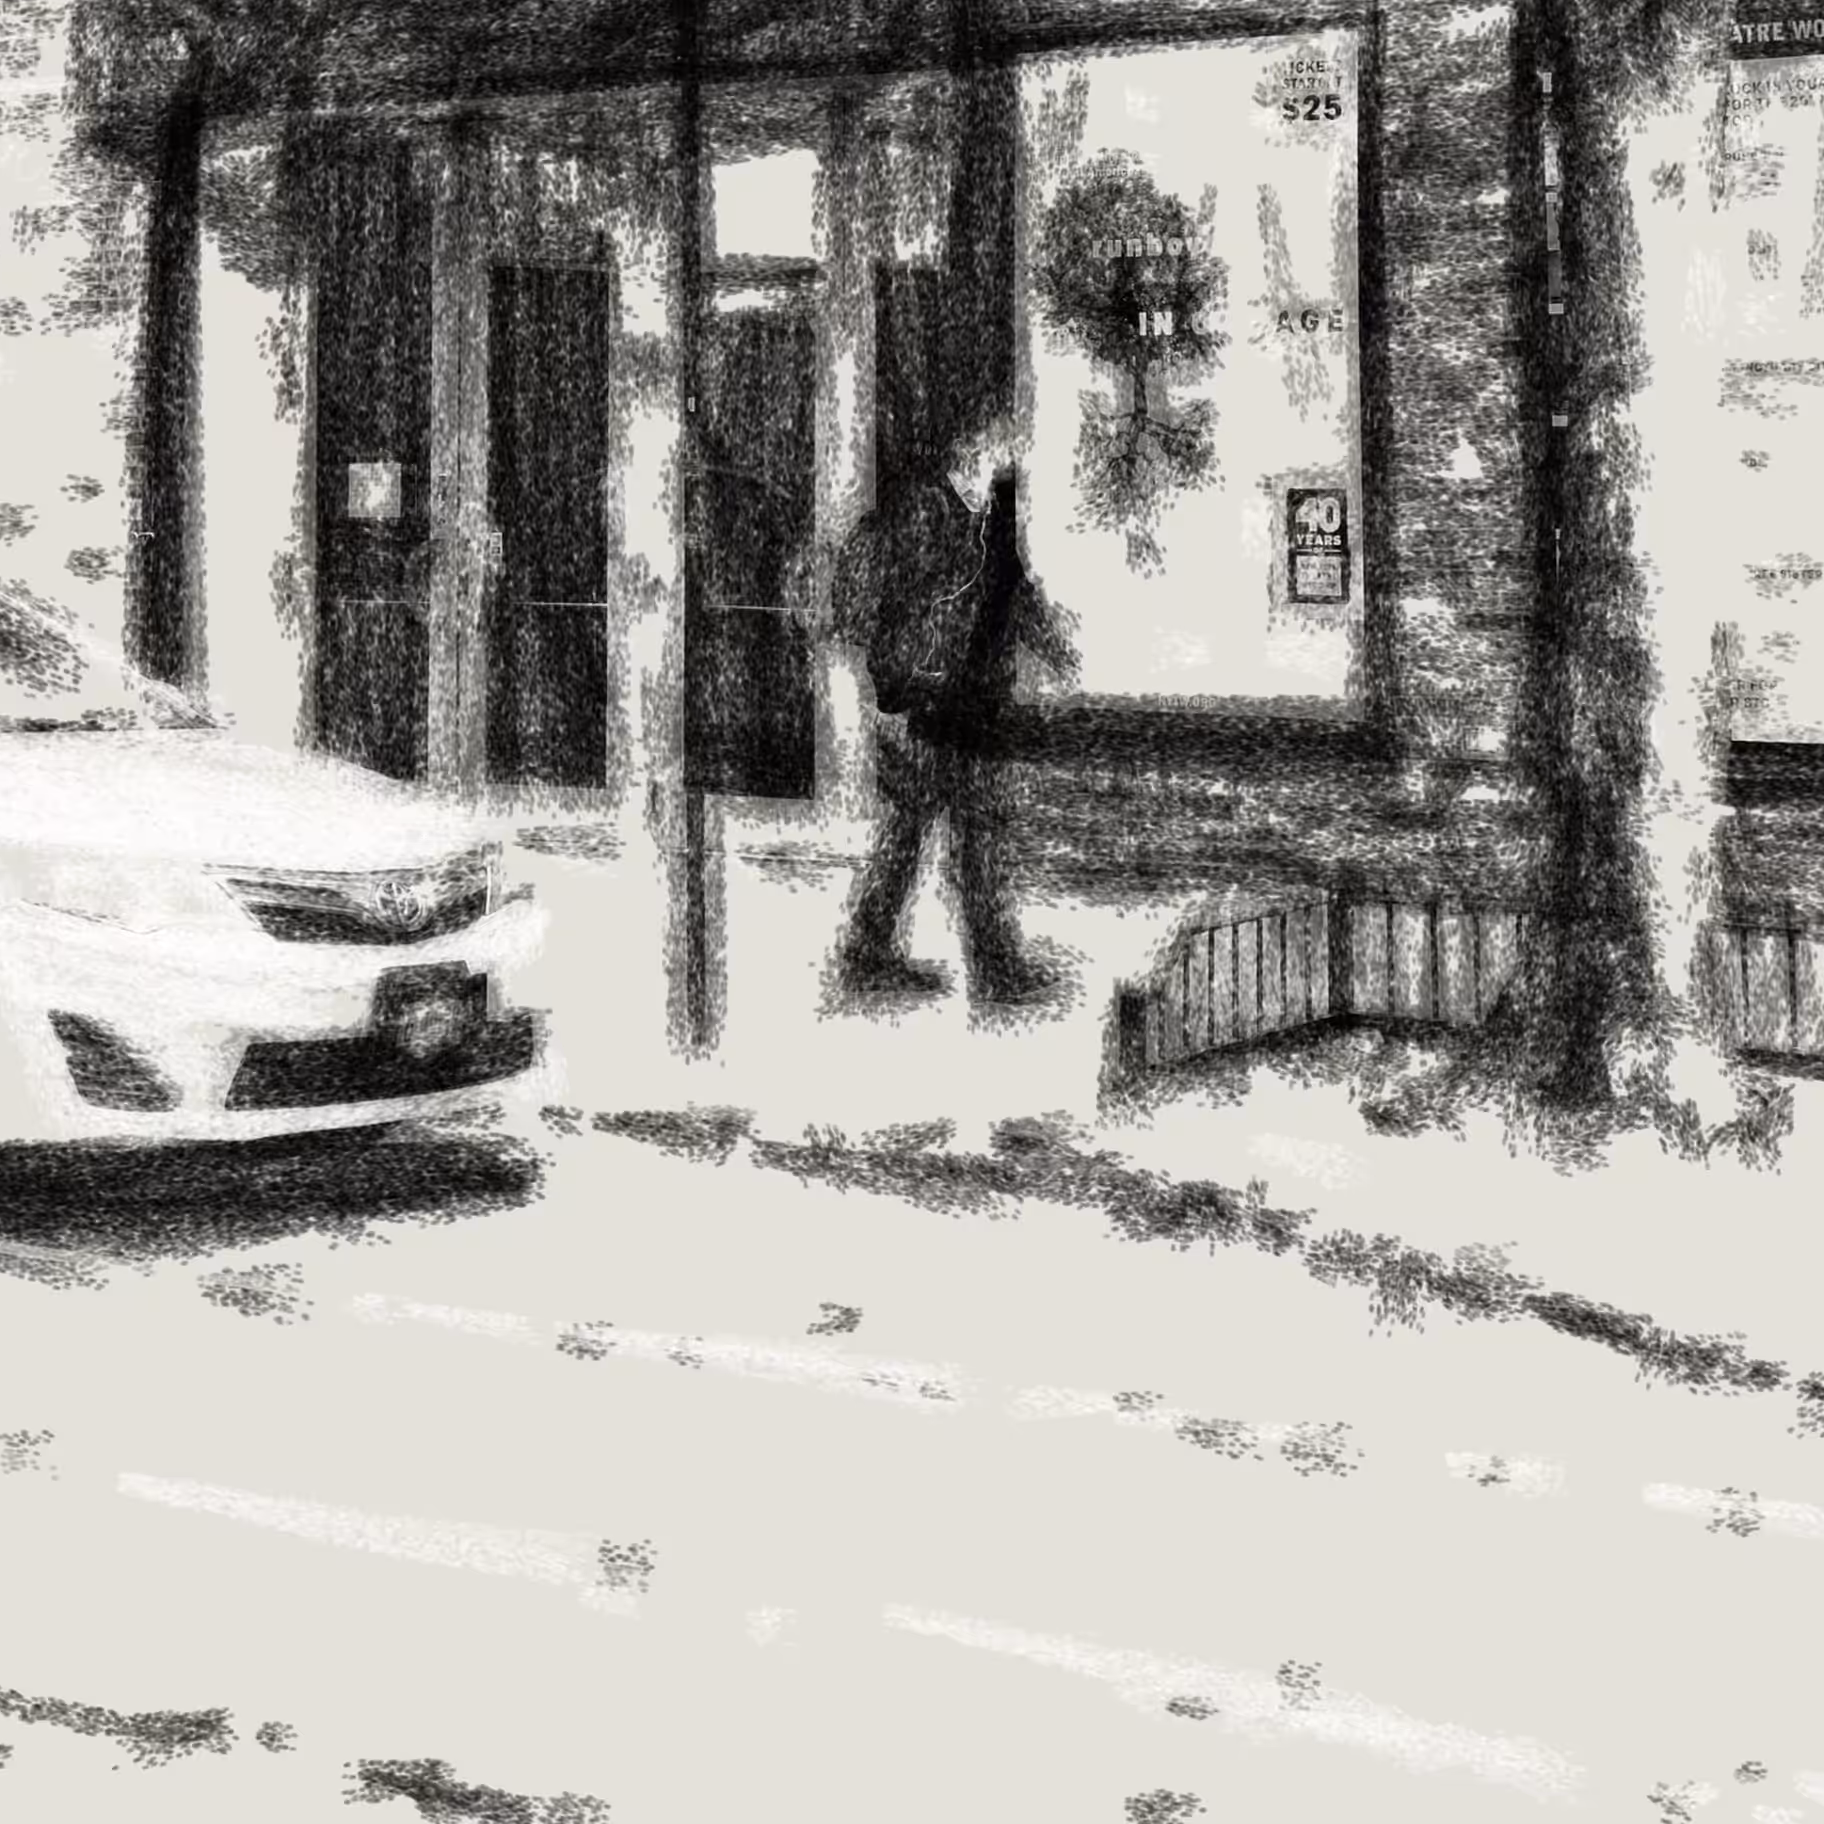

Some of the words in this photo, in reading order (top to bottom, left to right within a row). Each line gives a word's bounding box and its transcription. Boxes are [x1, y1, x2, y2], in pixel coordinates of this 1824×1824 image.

[1283, 60, 1342, 74] ICKE
[1139, 311, 1174, 336] IN
[1277, 308, 1344, 333] AGE
[1295, 496, 1341, 533] 40
[1296, 534, 1342, 546] YEARS
